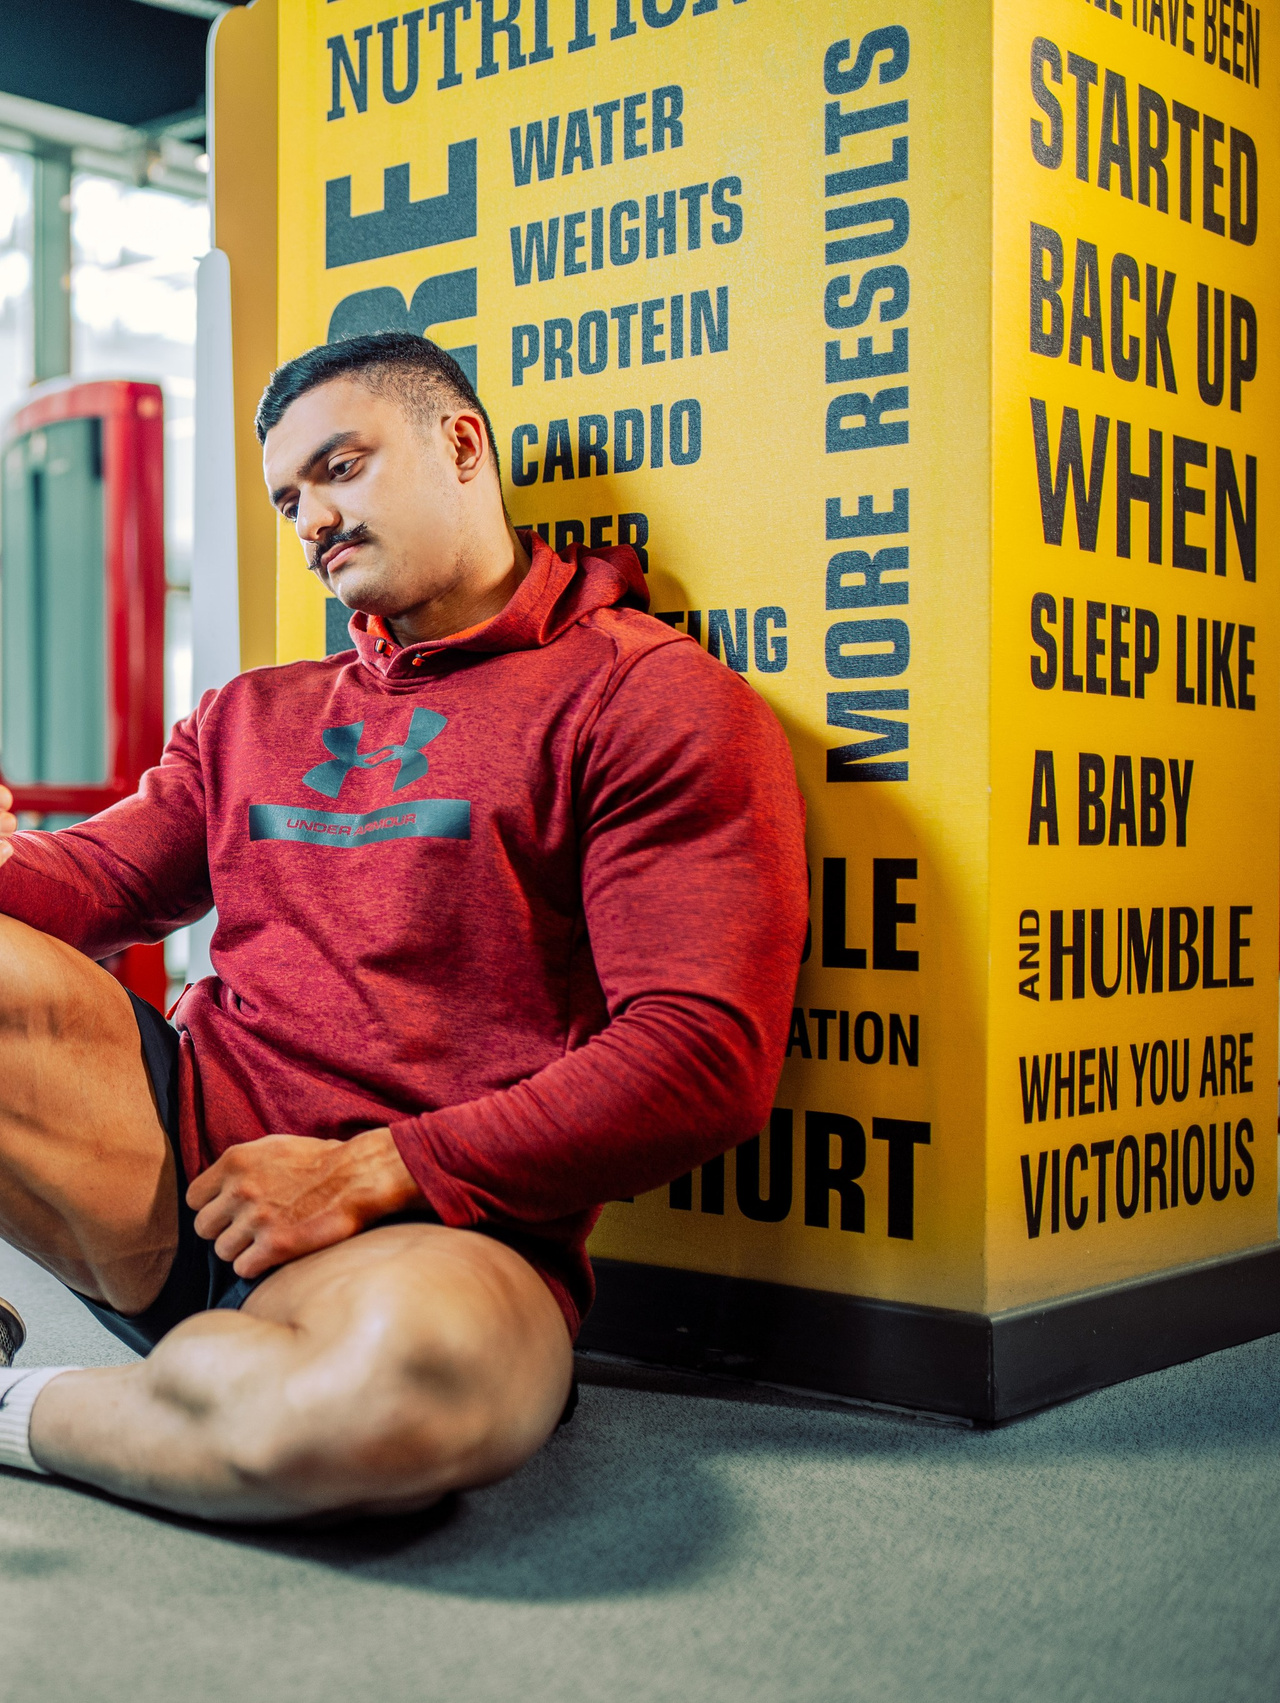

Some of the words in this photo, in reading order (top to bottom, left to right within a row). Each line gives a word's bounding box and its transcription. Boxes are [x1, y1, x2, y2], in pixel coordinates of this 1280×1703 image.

[1204, 0, 1260, 89] BEEN
[510, 85, 684, 187] WATER
[1031, 36, 1258, 246] STARTED
[510, 175, 744, 286] WEIGHTS
[823, 24, 910, 454] RESULTS
[511, 285, 729, 387] PROTEIN
[1030, 221, 1178, 394] BACK
[1197, 281, 1258, 413] UP
[511, 398, 702, 487] CARDIO
[1030, 397, 1257, 583] WHEN
[824, 487, 910, 783] MORE
[1030, 592, 1160, 699] SLEEP
[1176, 614, 1256, 711] LIKE
[287, 818, 352, 836] UNDER
[353, 813, 417, 837] ARMOUR
[1028, 749, 1059, 845] A
[1078, 752, 1195, 847] BABY
[1019, 909, 1041, 1002] AND
[1049, 905, 1254, 1002] HUMBLE
[1019, 1045, 1119, 1124] WHEN
[1129, 1037, 1190, 1107] YOU
[1199, 1032, 1254, 1098] ARE
[1020, 1117, 1255, 1240] VICTORIOUS
